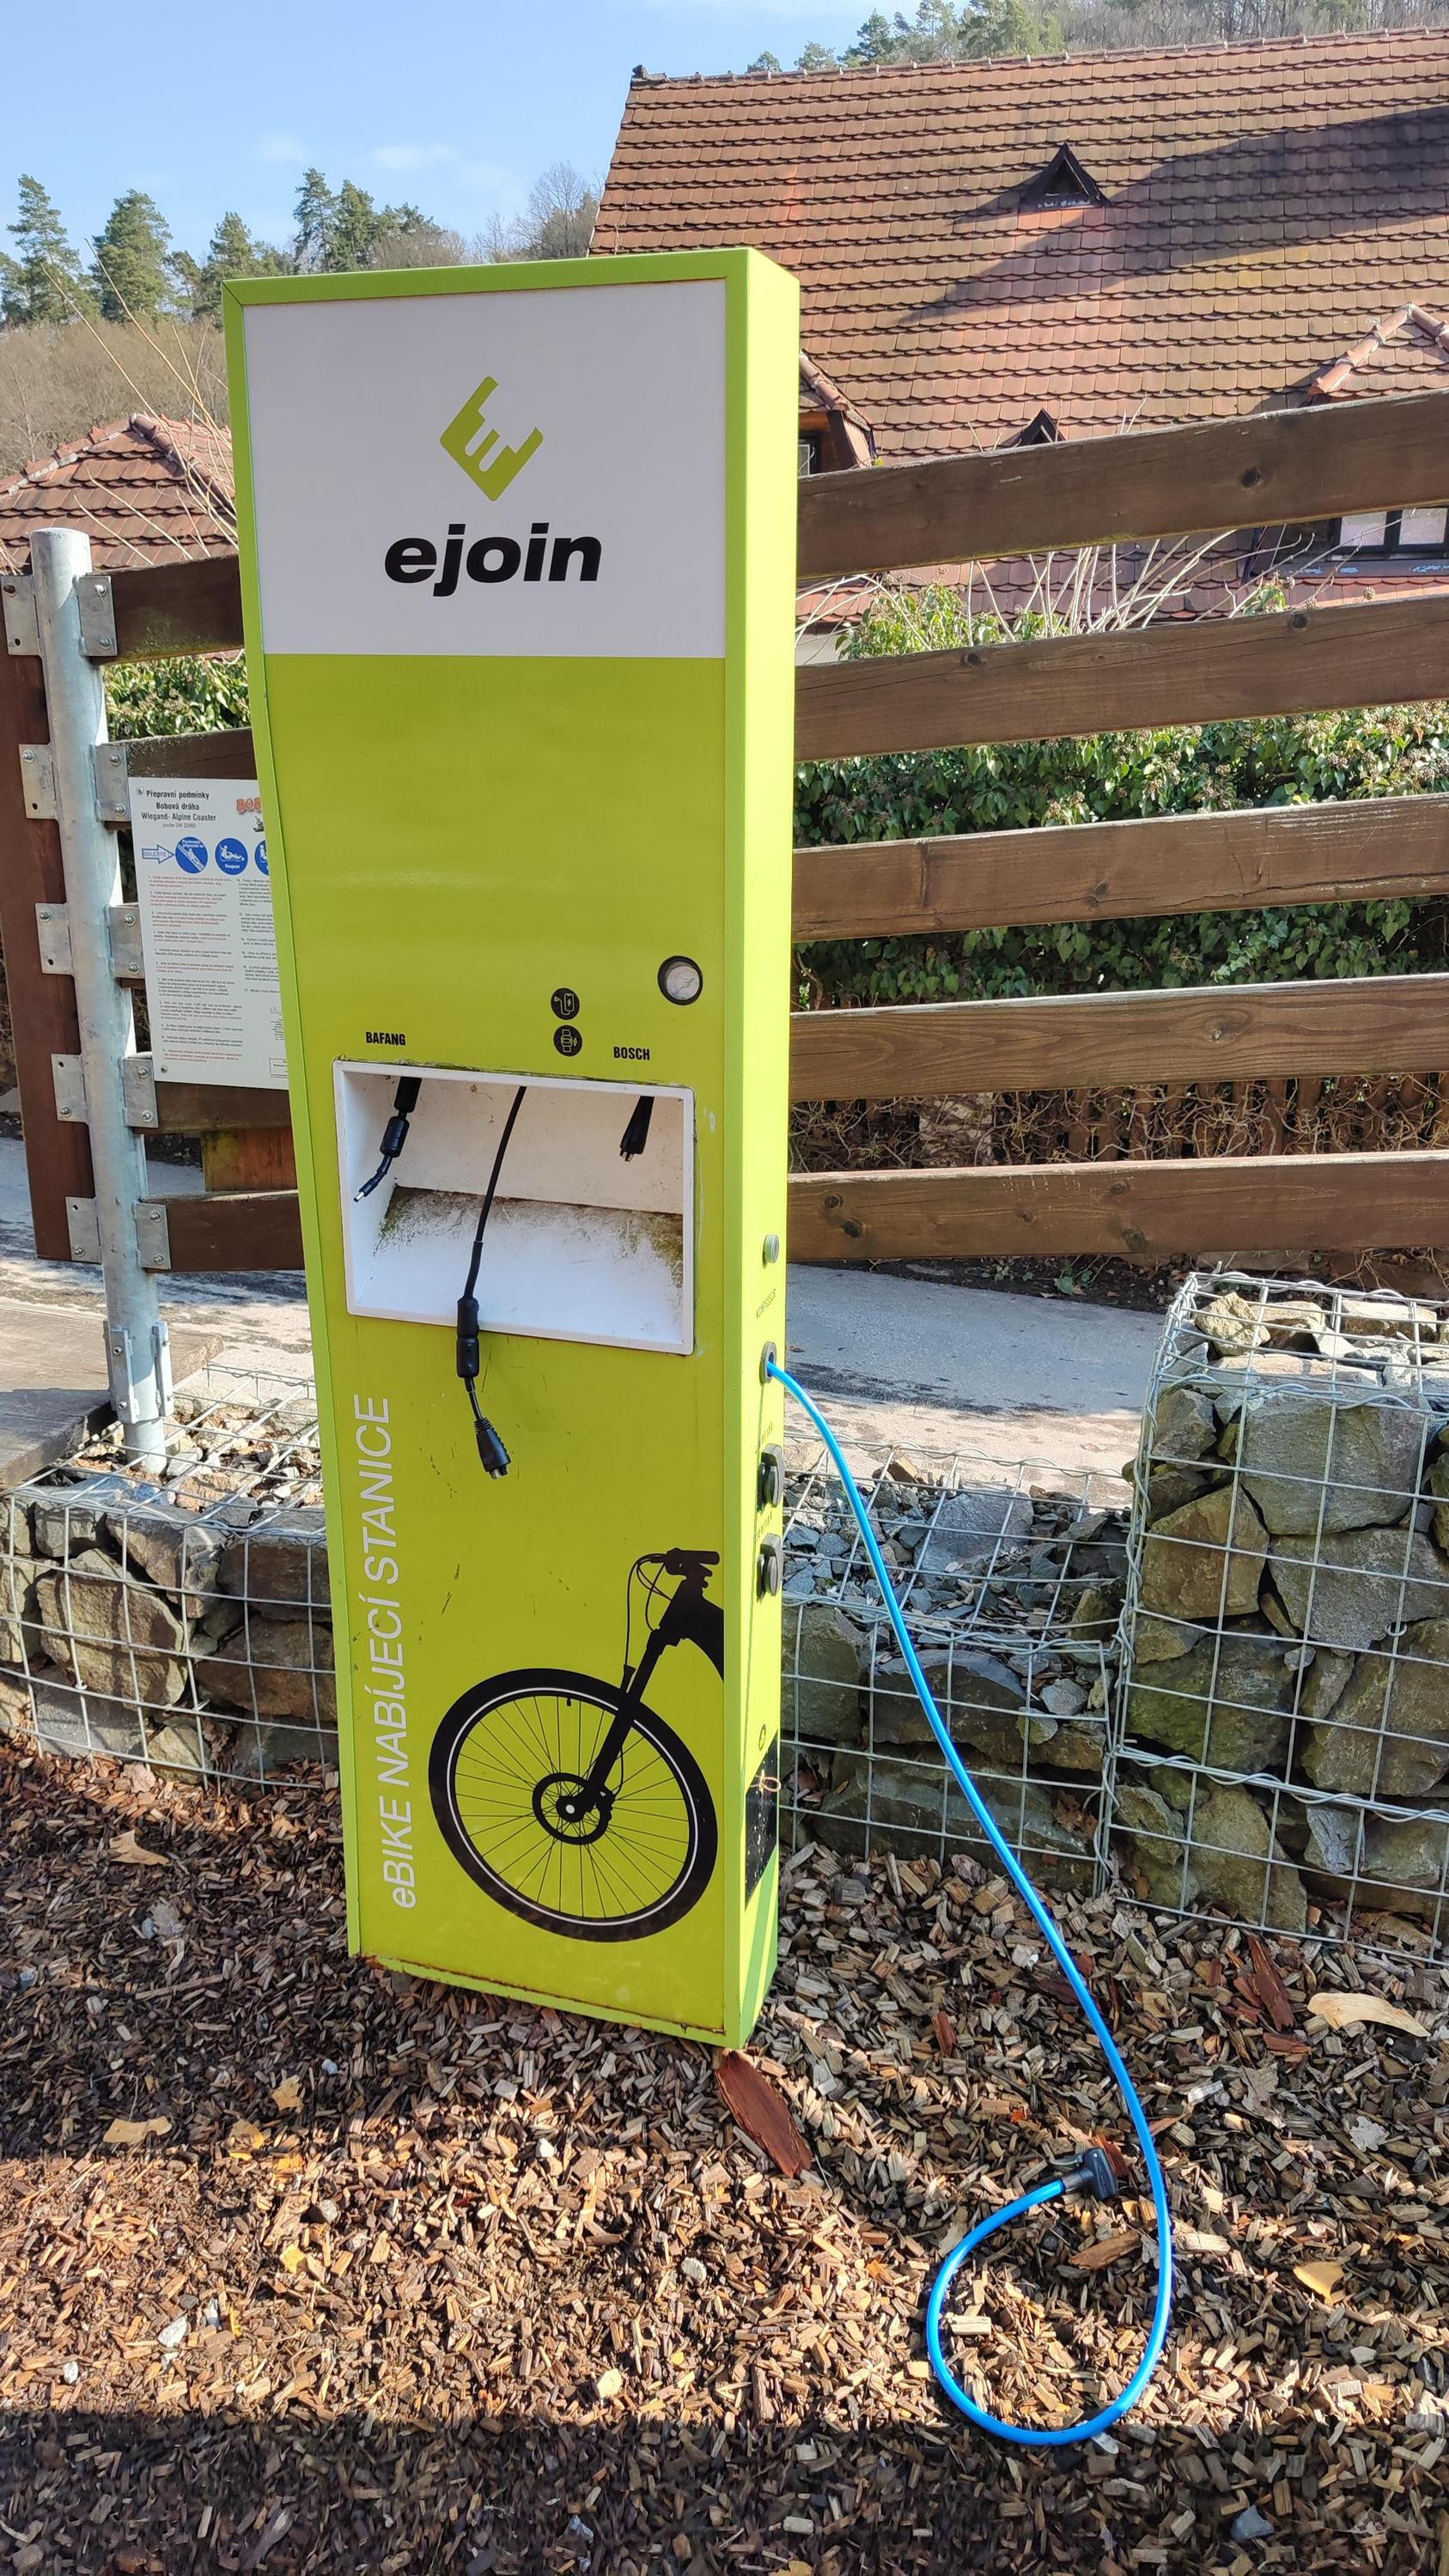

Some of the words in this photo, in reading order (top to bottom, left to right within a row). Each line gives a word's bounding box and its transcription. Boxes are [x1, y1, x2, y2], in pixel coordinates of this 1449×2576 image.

[384, 522, 602, 598] ejoin
[146, 789, 177, 799] Přepravní
[179, 791, 210, 800] podmínky
[155, 802, 180, 811] Bobová
[172, 812, 192, 822] Alpine
[365, 1031, 407, 1047] BAFANG
[613, 1046, 651, 1061] BOSCH
[354, 1394, 399, 1584] STANICE
[358, 1594, 410, 1787] NABÍJECÍ
[379, 1795, 417, 1909] eBIKE
